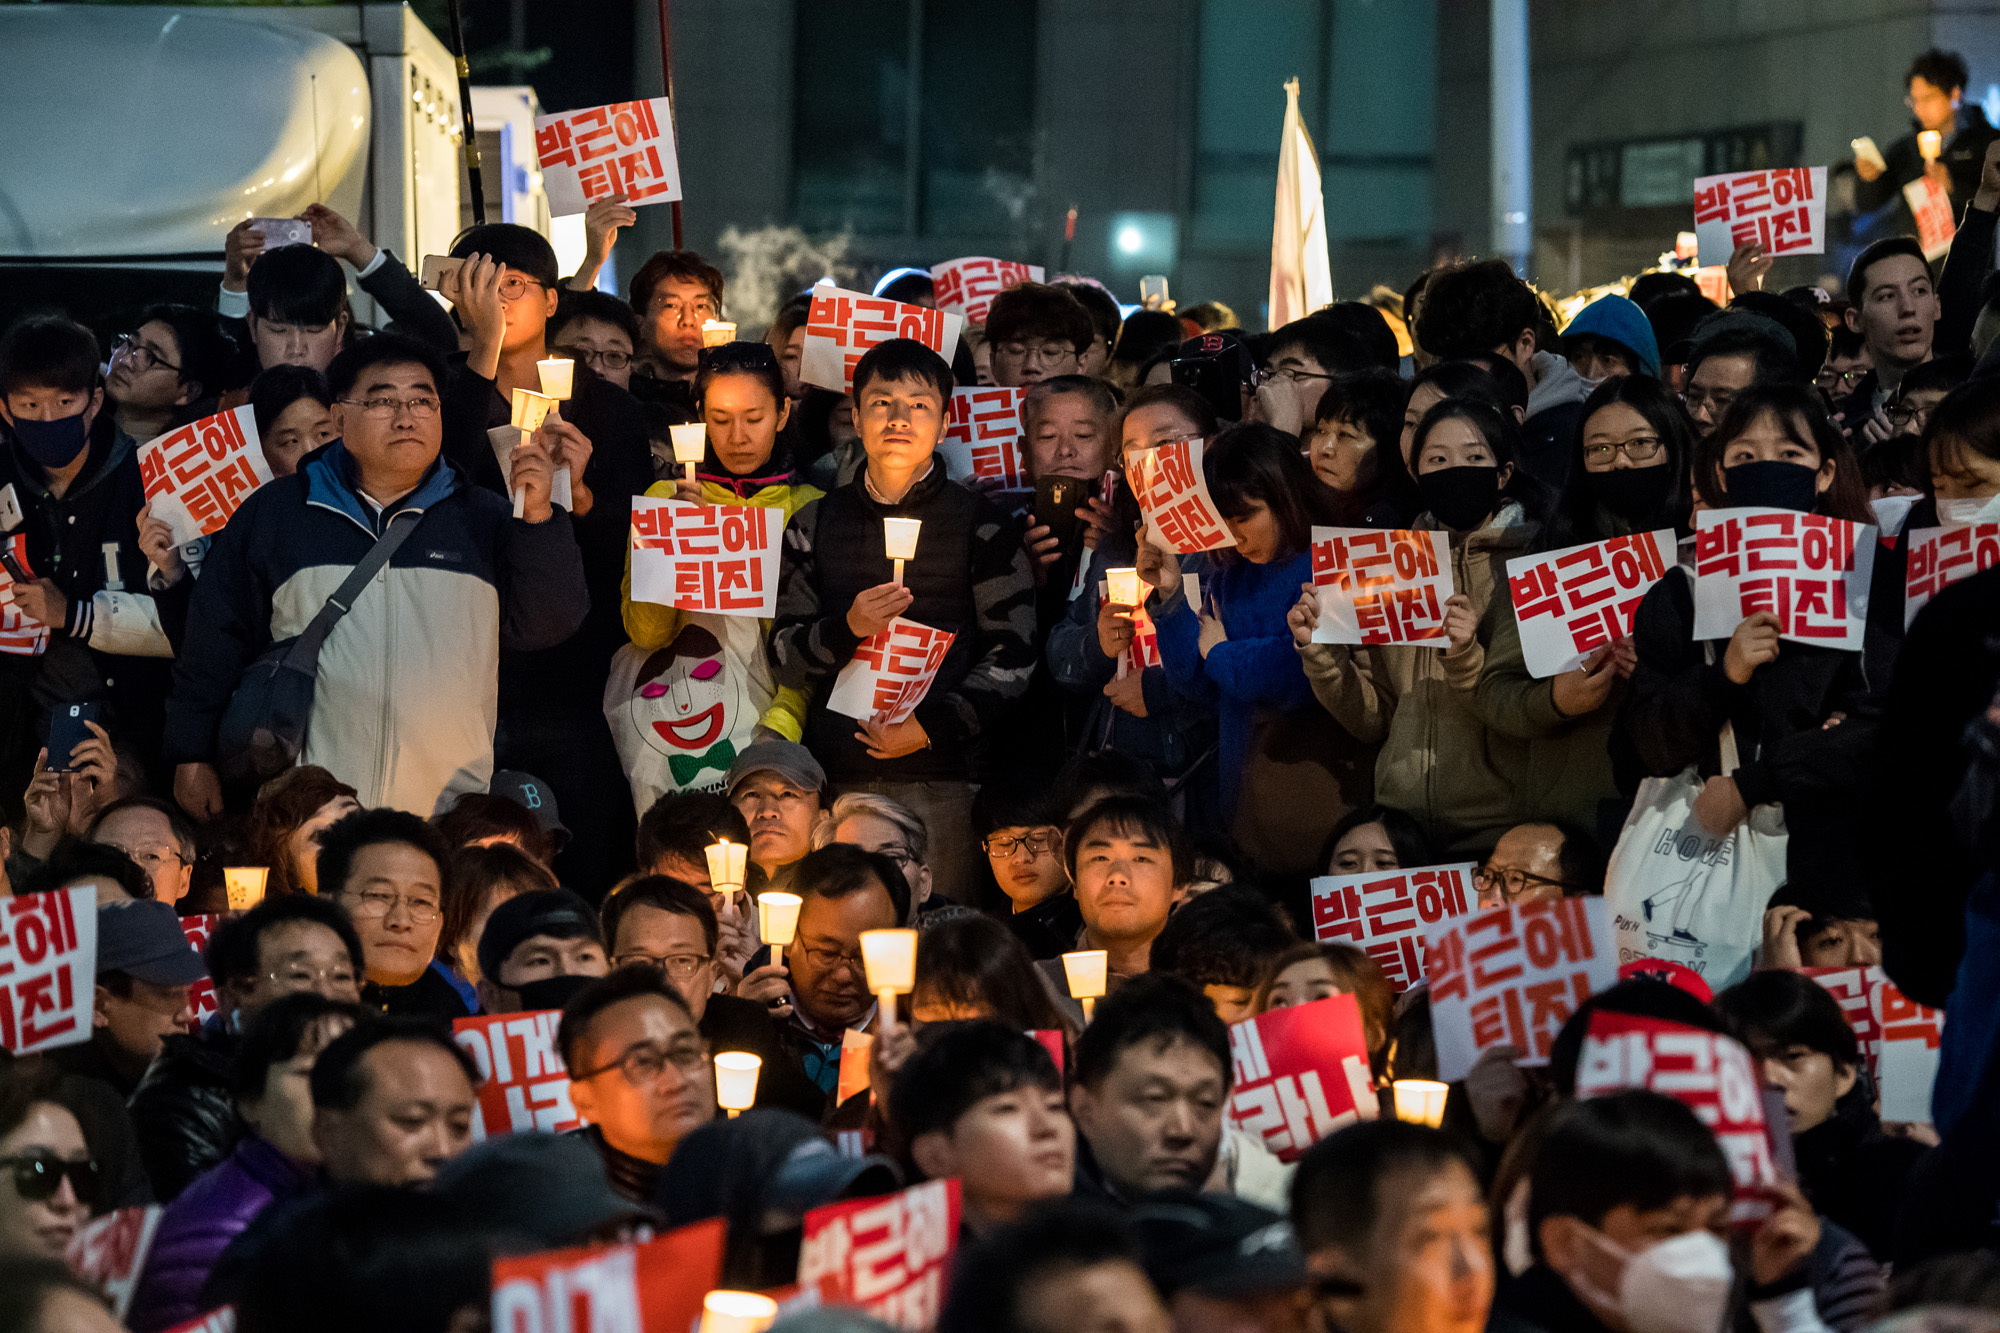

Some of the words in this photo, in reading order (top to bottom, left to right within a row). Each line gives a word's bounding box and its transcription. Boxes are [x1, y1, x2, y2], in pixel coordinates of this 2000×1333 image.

[535, 99, 659, 168] 박근혜
[578, 145, 668, 209] 퇴진
[1694, 167, 1813, 225] 박근혜
[1730, 206, 1812, 253] 퇴진
[807, 296, 944, 353] 박근혜
[1200, 335, 1224, 352] B
[944, 388, 1030, 444] 박근
[139, 408, 247, 501] 박근혜
[971, 441, 1031, 490] 퇴
[180, 455, 261, 536] 퇴진
[1155, 494, 1226, 554] 퇴진
[632, 505, 767, 556] 박근혜
[1312, 529, 1439, 591] 박근혜
[1696, 513, 1855, 578] 박근혜
[674, 557, 764, 610] 퇴진
[1509, 531, 1667, 622] 박근혜
[1353, 584, 1445, 644] 퇴진
[1739, 577, 1847, 638] 퇴진
[519, 783, 541, 809] B
[0, 885, 78, 966] 혜
[1314, 870, 1468, 941] 박근혜
[1614, 914, 1640, 932] PUSH
[1365, 934, 1430, 994] 퇴
[1426, 898, 1594, 1003] 박근혜
[0, 963, 76, 1052] 진
